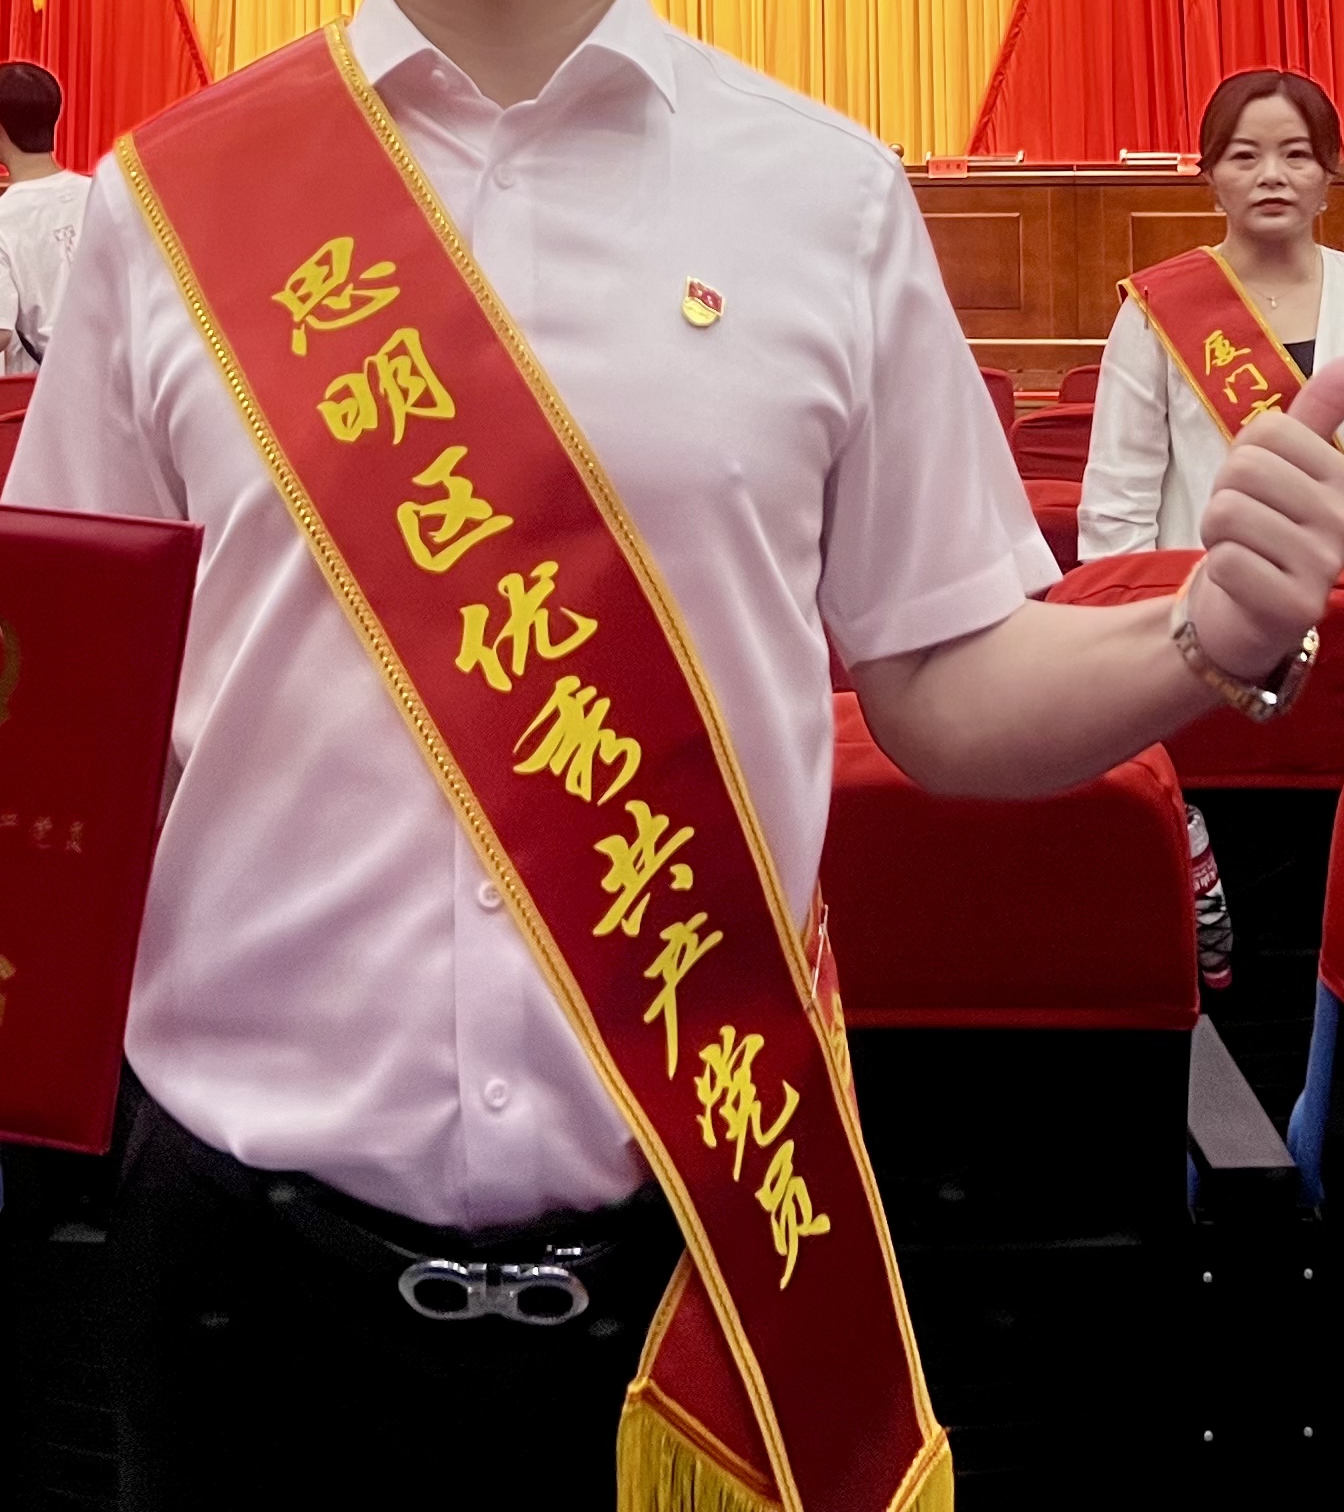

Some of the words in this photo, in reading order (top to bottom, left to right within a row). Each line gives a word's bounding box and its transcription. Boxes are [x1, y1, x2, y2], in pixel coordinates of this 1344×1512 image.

[271, 235, 833, 1291] 思明区优秀共产党员
